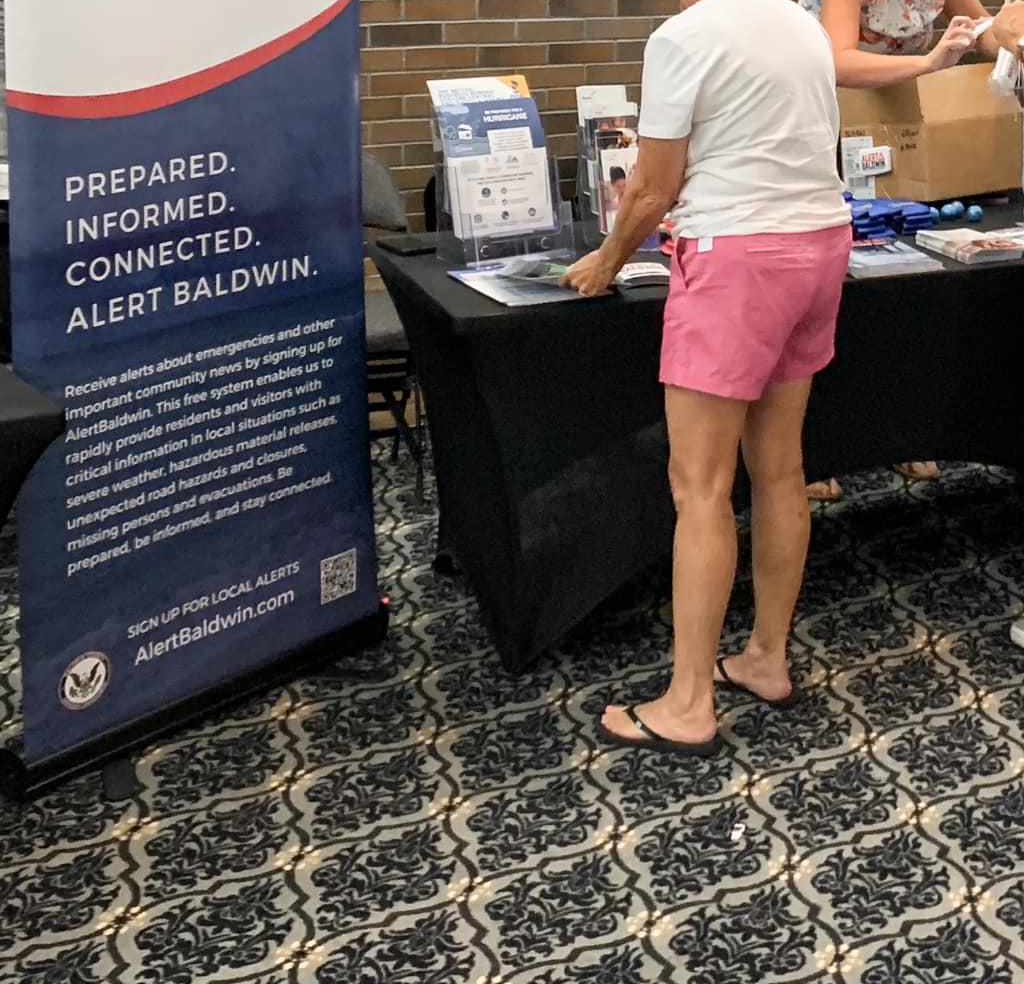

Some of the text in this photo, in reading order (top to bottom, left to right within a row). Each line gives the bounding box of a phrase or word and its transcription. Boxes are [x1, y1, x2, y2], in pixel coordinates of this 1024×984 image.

[483, 112, 528, 123] HURRICANE
[65, 151, 236, 202] PREPARED.
[65, 191, 236, 245] INFORMED.
[65, 225, 261, 288] CONNECTED.
[66, 254, 318, 334] ALERT BALDWIN.
[64, 318, 336, 398] Receive alerts about emergencies and other
[64, 336, 343, 421] important community news by signing up for
[64, 357, 334, 443] AlertBaldwin. This free system enables us to
[65, 379, 322, 464] rapidly provide residents and visitors with
[65, 394, 341, 486] critical information in local situations such as
[66, 486, 109, 509] severe
[169, 444, 234, 473] hazardous
[236, 426, 287, 453] material
[67, 492, 145, 530] unexpected
[147, 481, 176, 502] road
[179, 466, 228, 490] hazards
[230, 456, 254, 475] and
[67, 525, 119, 552] missing
[122, 507, 171, 535] persons
[172, 494, 197, 514] and
[277, 466, 294, 480] Be
[135, 535, 151, 549] be
[215, 500, 240, 520] and
[241, 495, 267, 511] stay
[127, 561, 300, 639] SIGN UP FOR LOCAL ALERTS
[134, 589, 295, 666] AlertBaldwin.com
